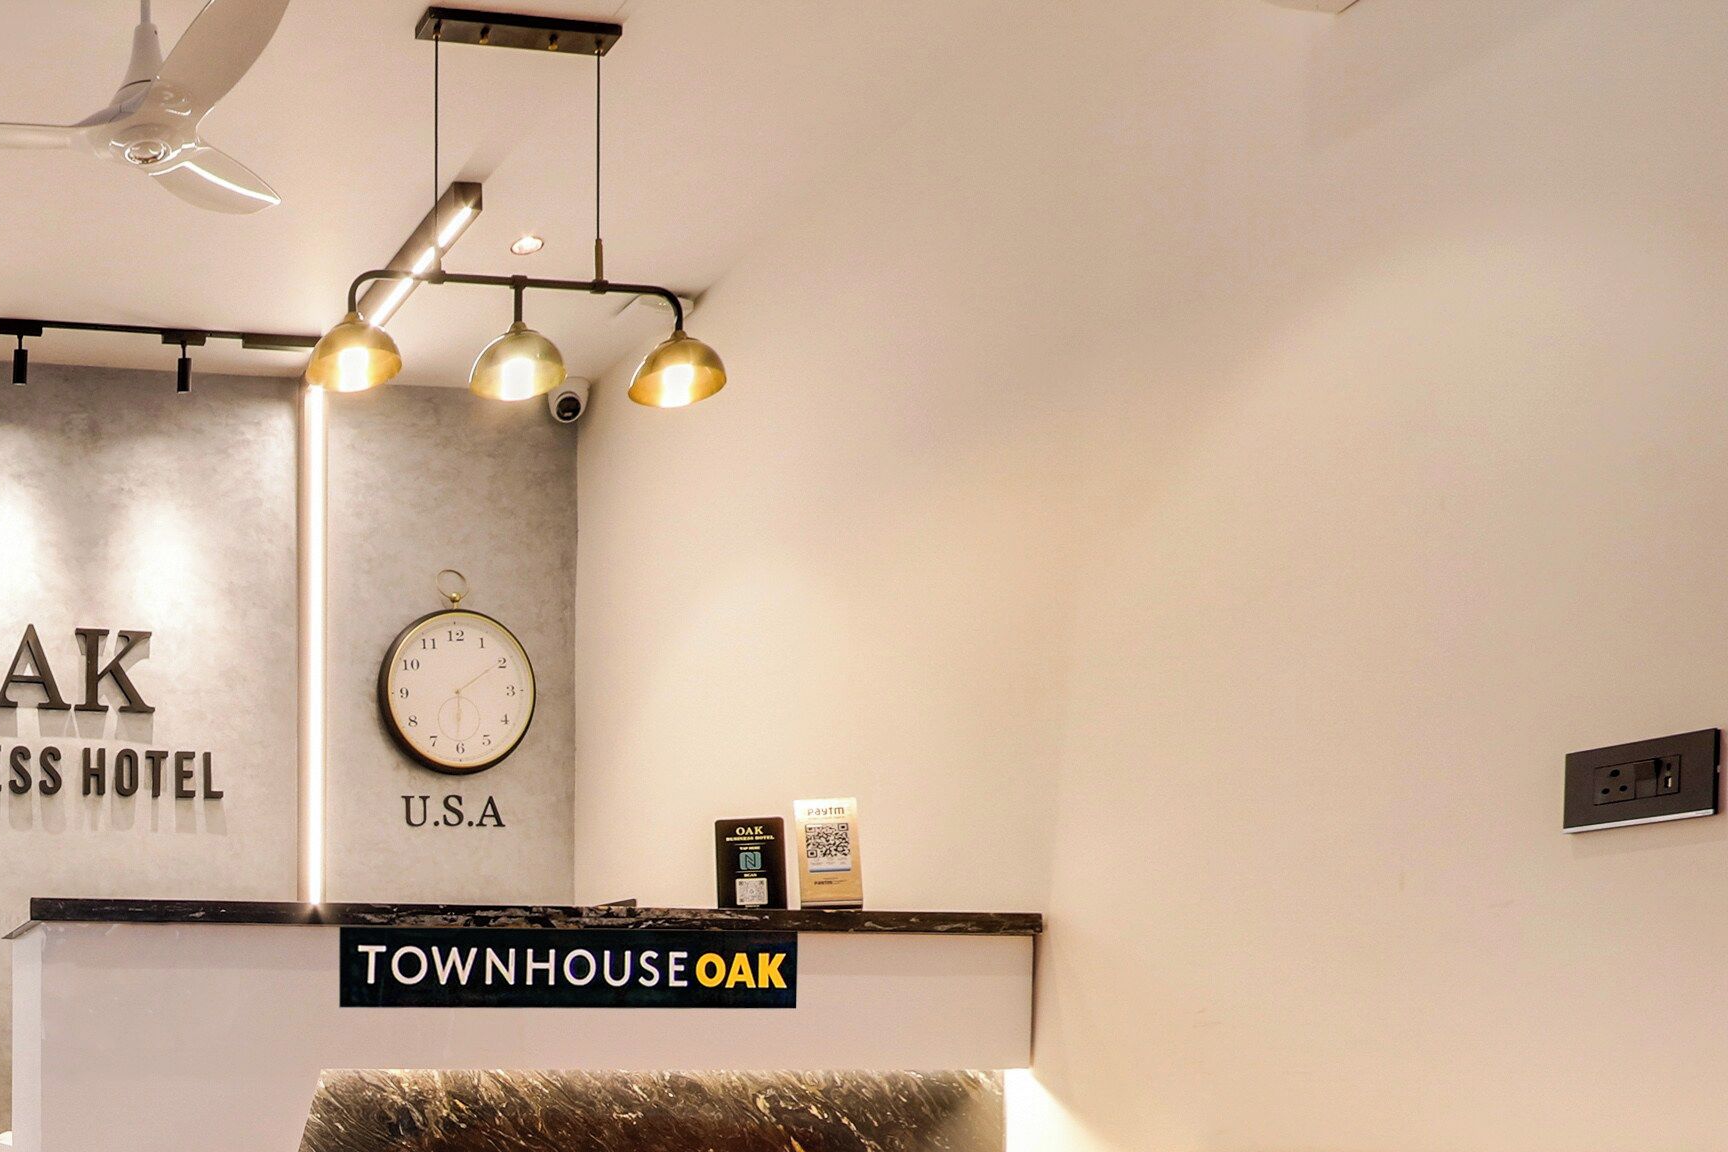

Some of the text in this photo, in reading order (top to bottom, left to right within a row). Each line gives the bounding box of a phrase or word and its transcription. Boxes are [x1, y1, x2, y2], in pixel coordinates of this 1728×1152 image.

[446, 629, 465, 642] 12
[422, 638, 437, 650] 11
[479, 637, 485, 649] 1
[401, 659, 420, 671] 10
[496, 657, 507, 669] 2
[399, 687, 409, 699] 9
[506, 685, 515, 697] 3
[408, 716, 419, 727] 8
[501, 714, 510, 725] 4
[429, 735, 438, 747] 7
[482, 734, 492, 746] 5
[455, 742, 466, 755] 6
[82, 747, 224, 800] HOTEL
[401, 795, 505, 827] U.S.A
[735, 826, 764, 836] OAK
